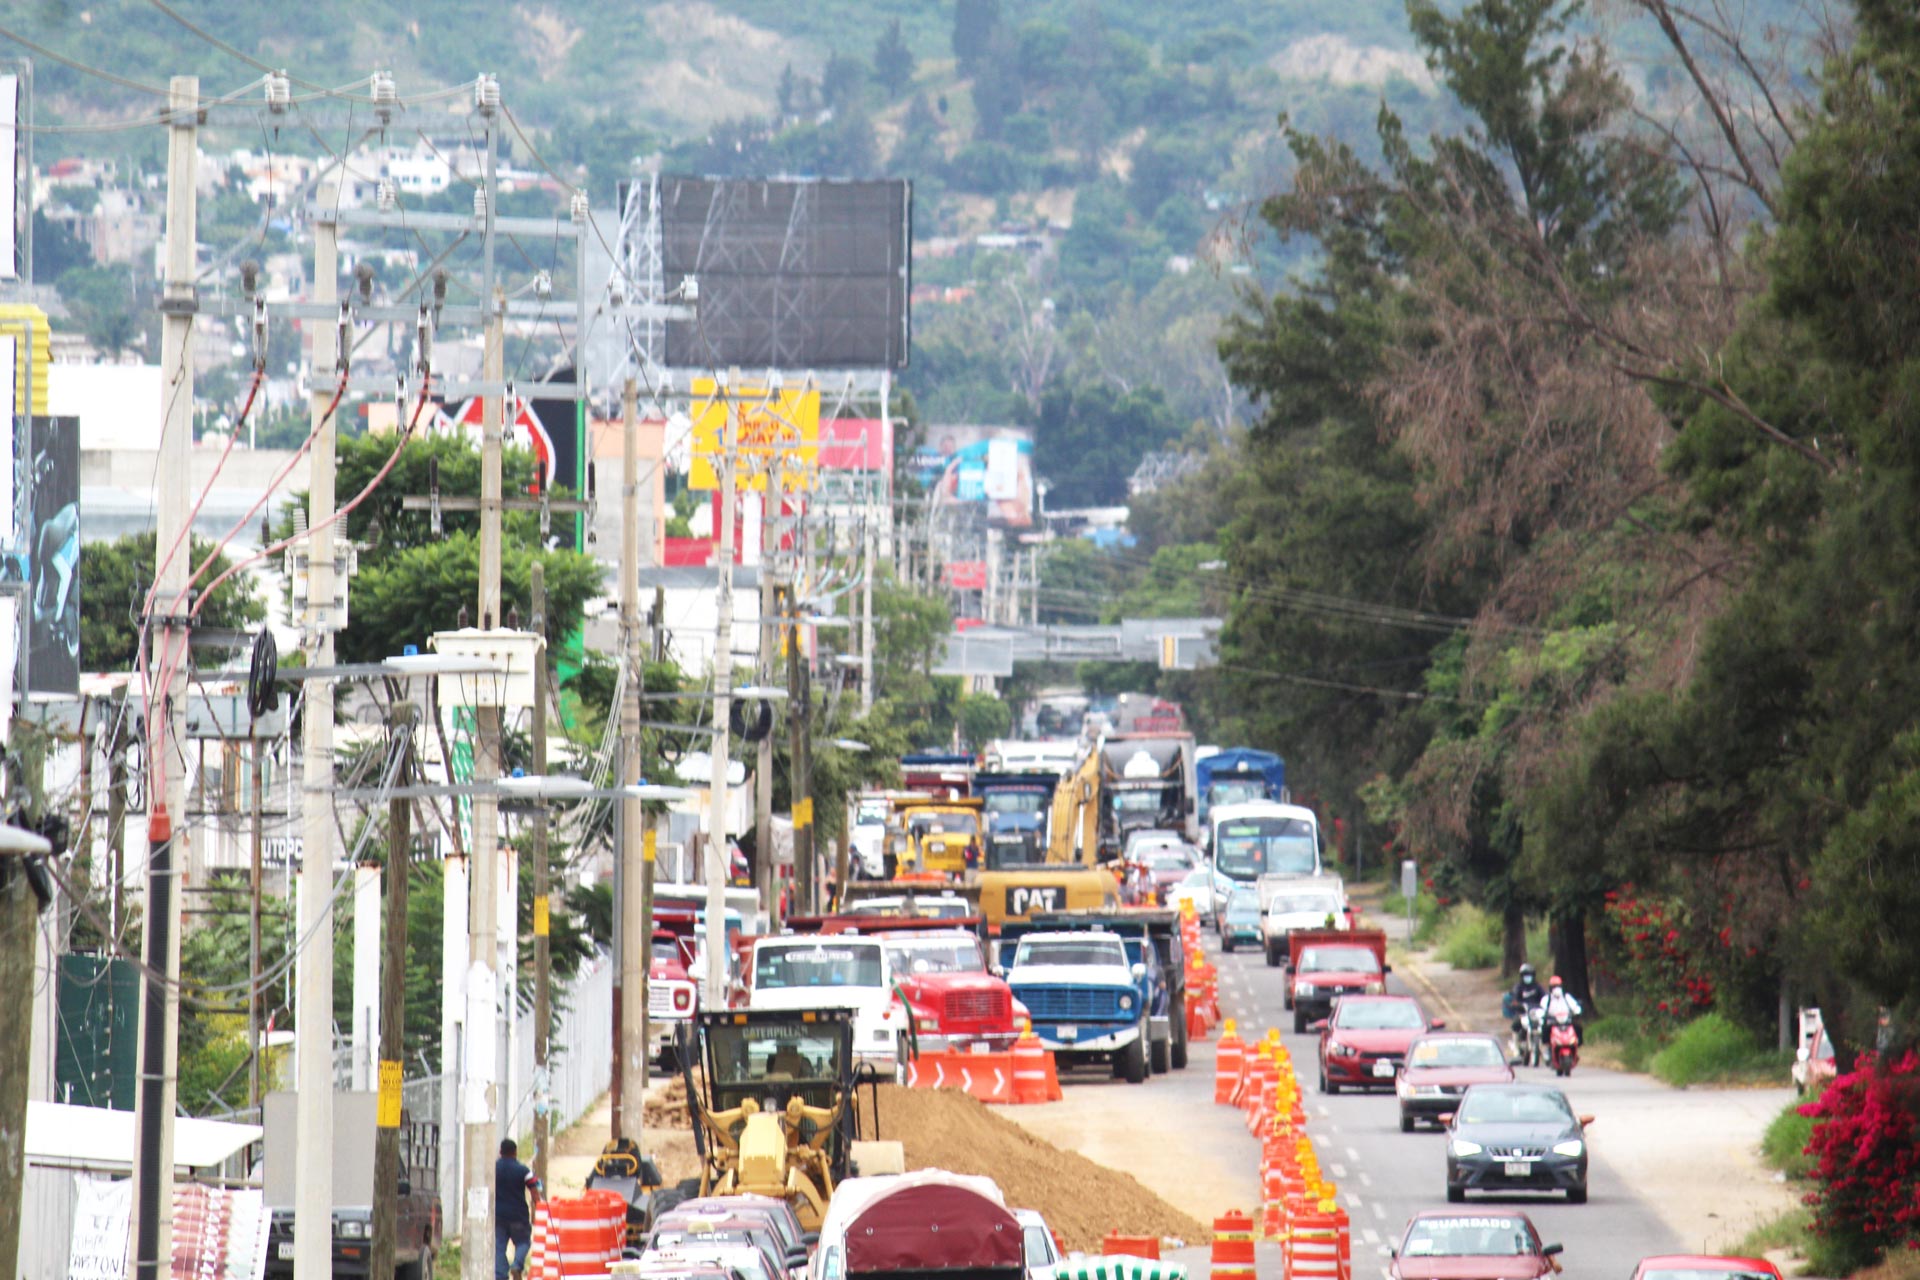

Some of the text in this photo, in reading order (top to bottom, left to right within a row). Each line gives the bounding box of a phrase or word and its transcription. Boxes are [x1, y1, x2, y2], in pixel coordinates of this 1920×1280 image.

[1013, 887, 1058, 915] CAT
[742, 1024, 810, 1040] CATERPILLAR
[1428, 1217, 1512, 1231] GUARDADO
